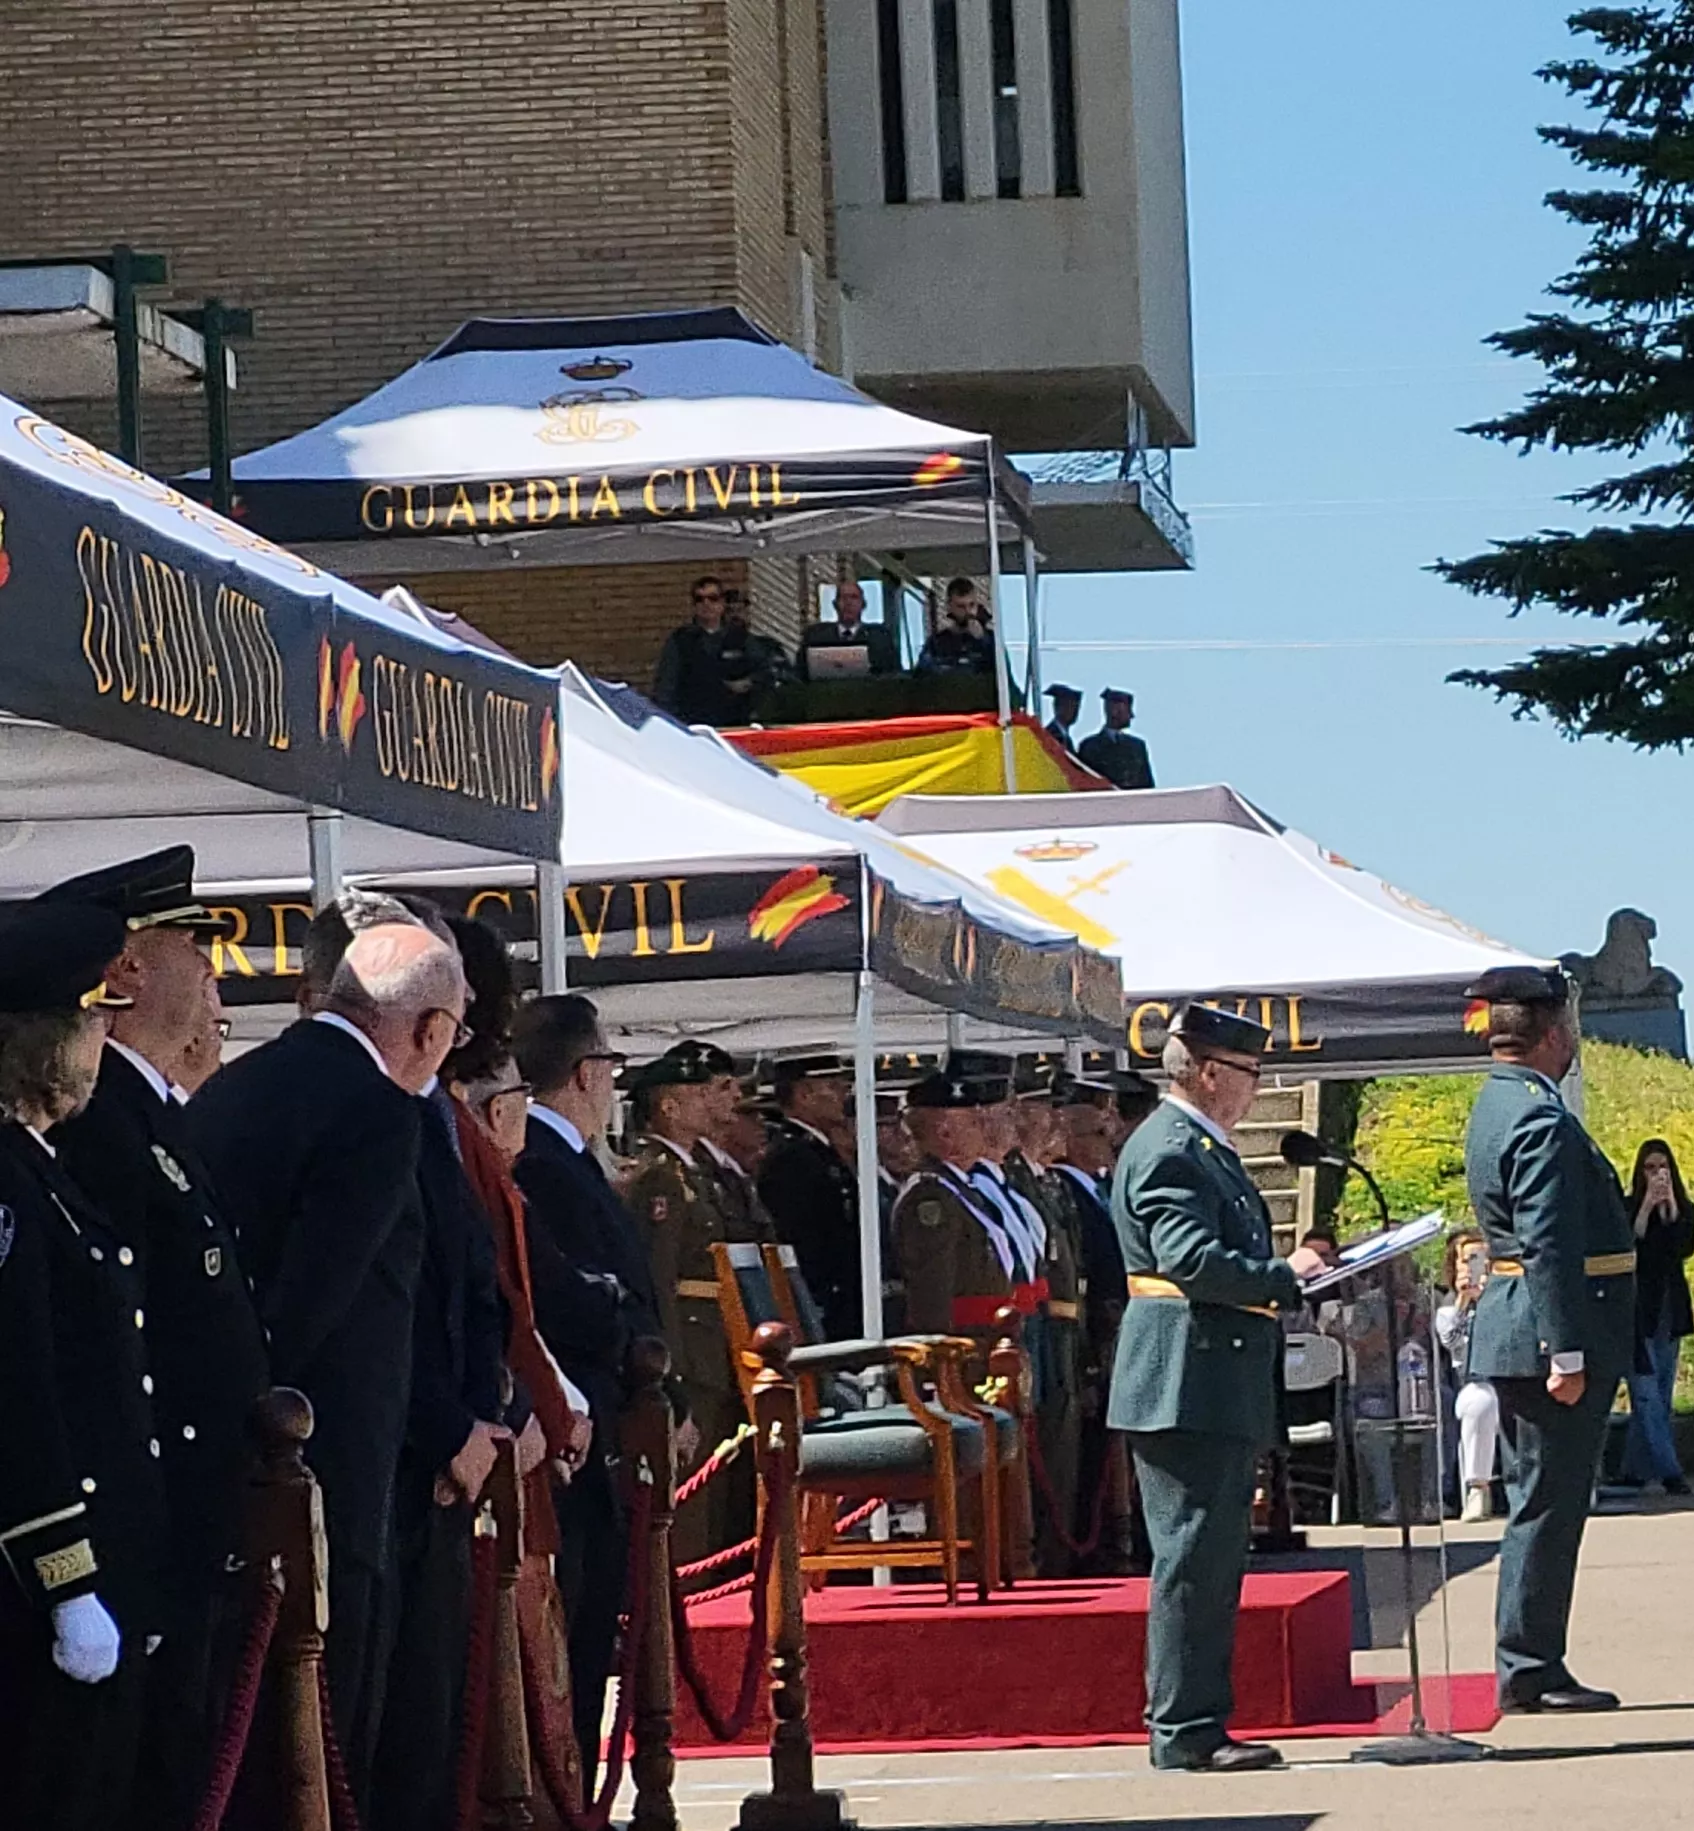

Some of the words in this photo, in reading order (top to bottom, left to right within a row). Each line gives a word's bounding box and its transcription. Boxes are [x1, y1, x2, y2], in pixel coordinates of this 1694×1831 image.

[361, 474, 622, 533] GUARDIA
[642, 462, 801, 517] CIVIL
[76, 524, 223, 728] GUARDIA
[214, 581, 290, 751] CIVIL
[373, 654, 485, 799] GUARDIA
[483, 689, 539, 812] CIVIL
